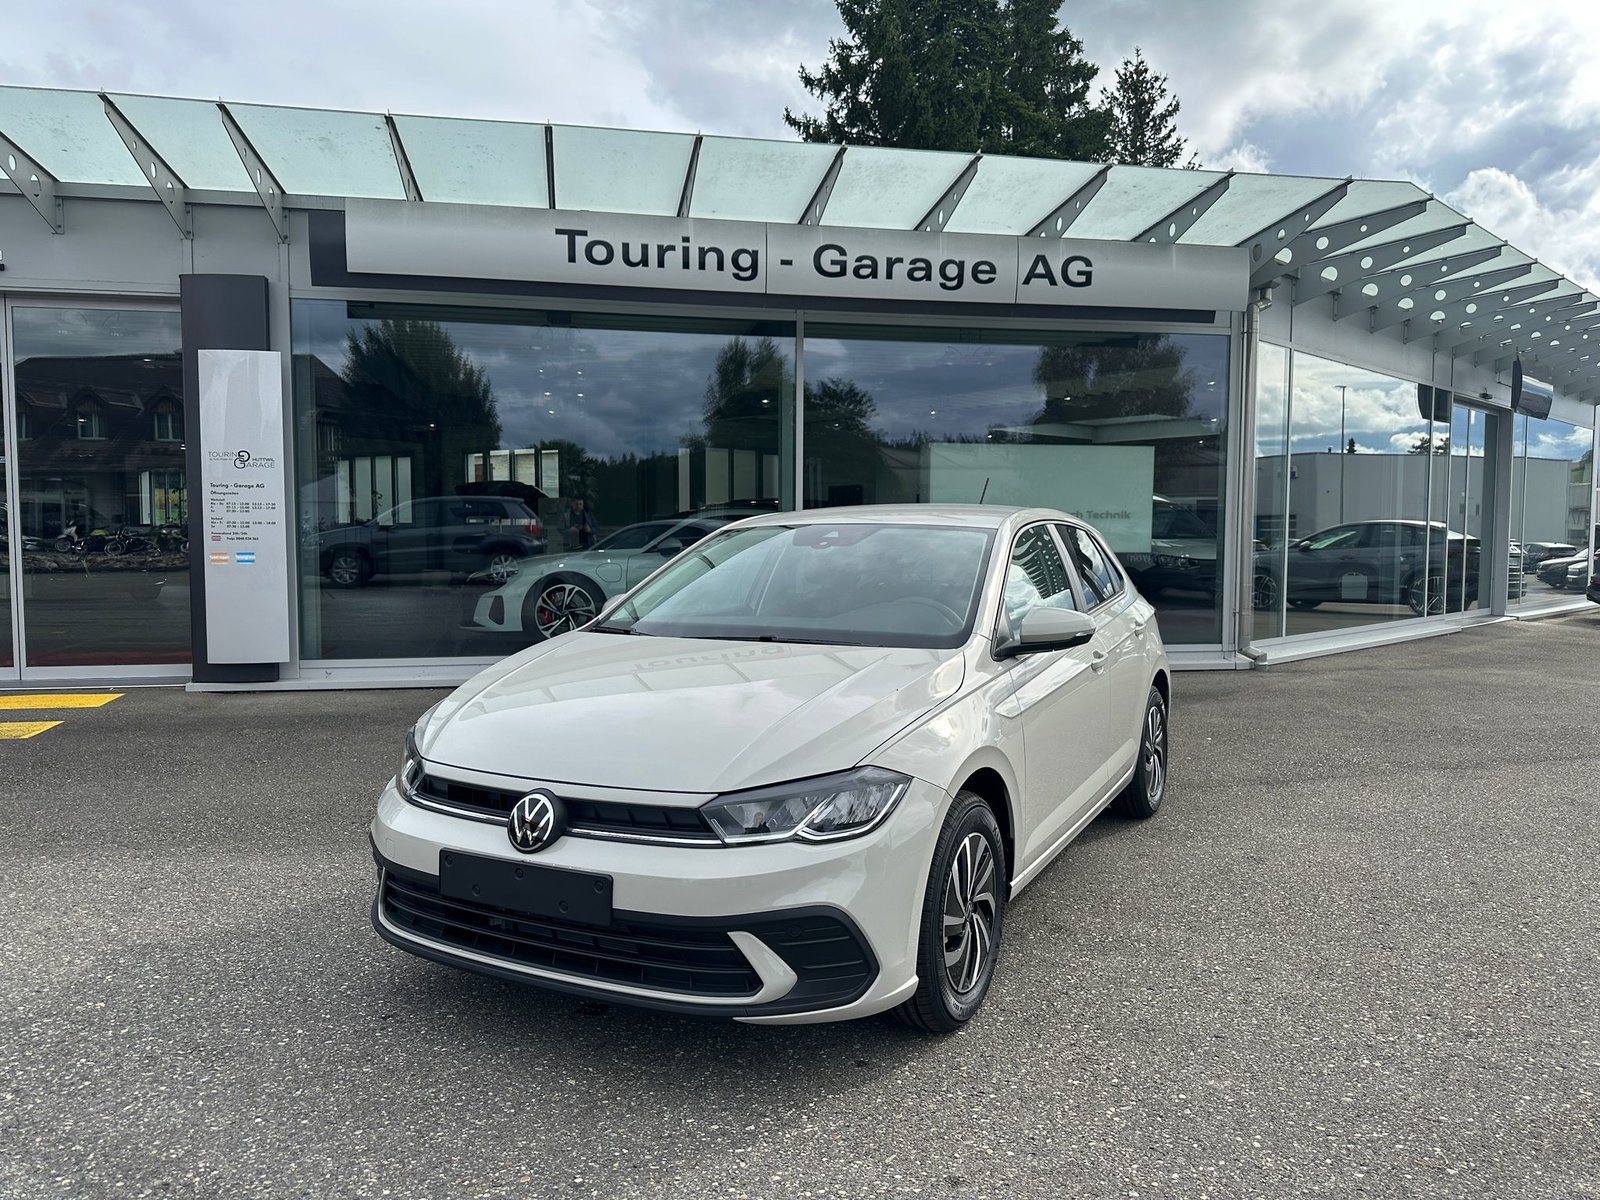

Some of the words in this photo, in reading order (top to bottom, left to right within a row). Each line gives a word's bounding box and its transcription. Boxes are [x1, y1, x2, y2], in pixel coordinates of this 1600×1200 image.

[555, 228, 759, 282] Touring
[813, 243, 997, 291] Garage
[1022, 254, 1093, 288] AG
[1086, 510, 1131, 519] Technik
